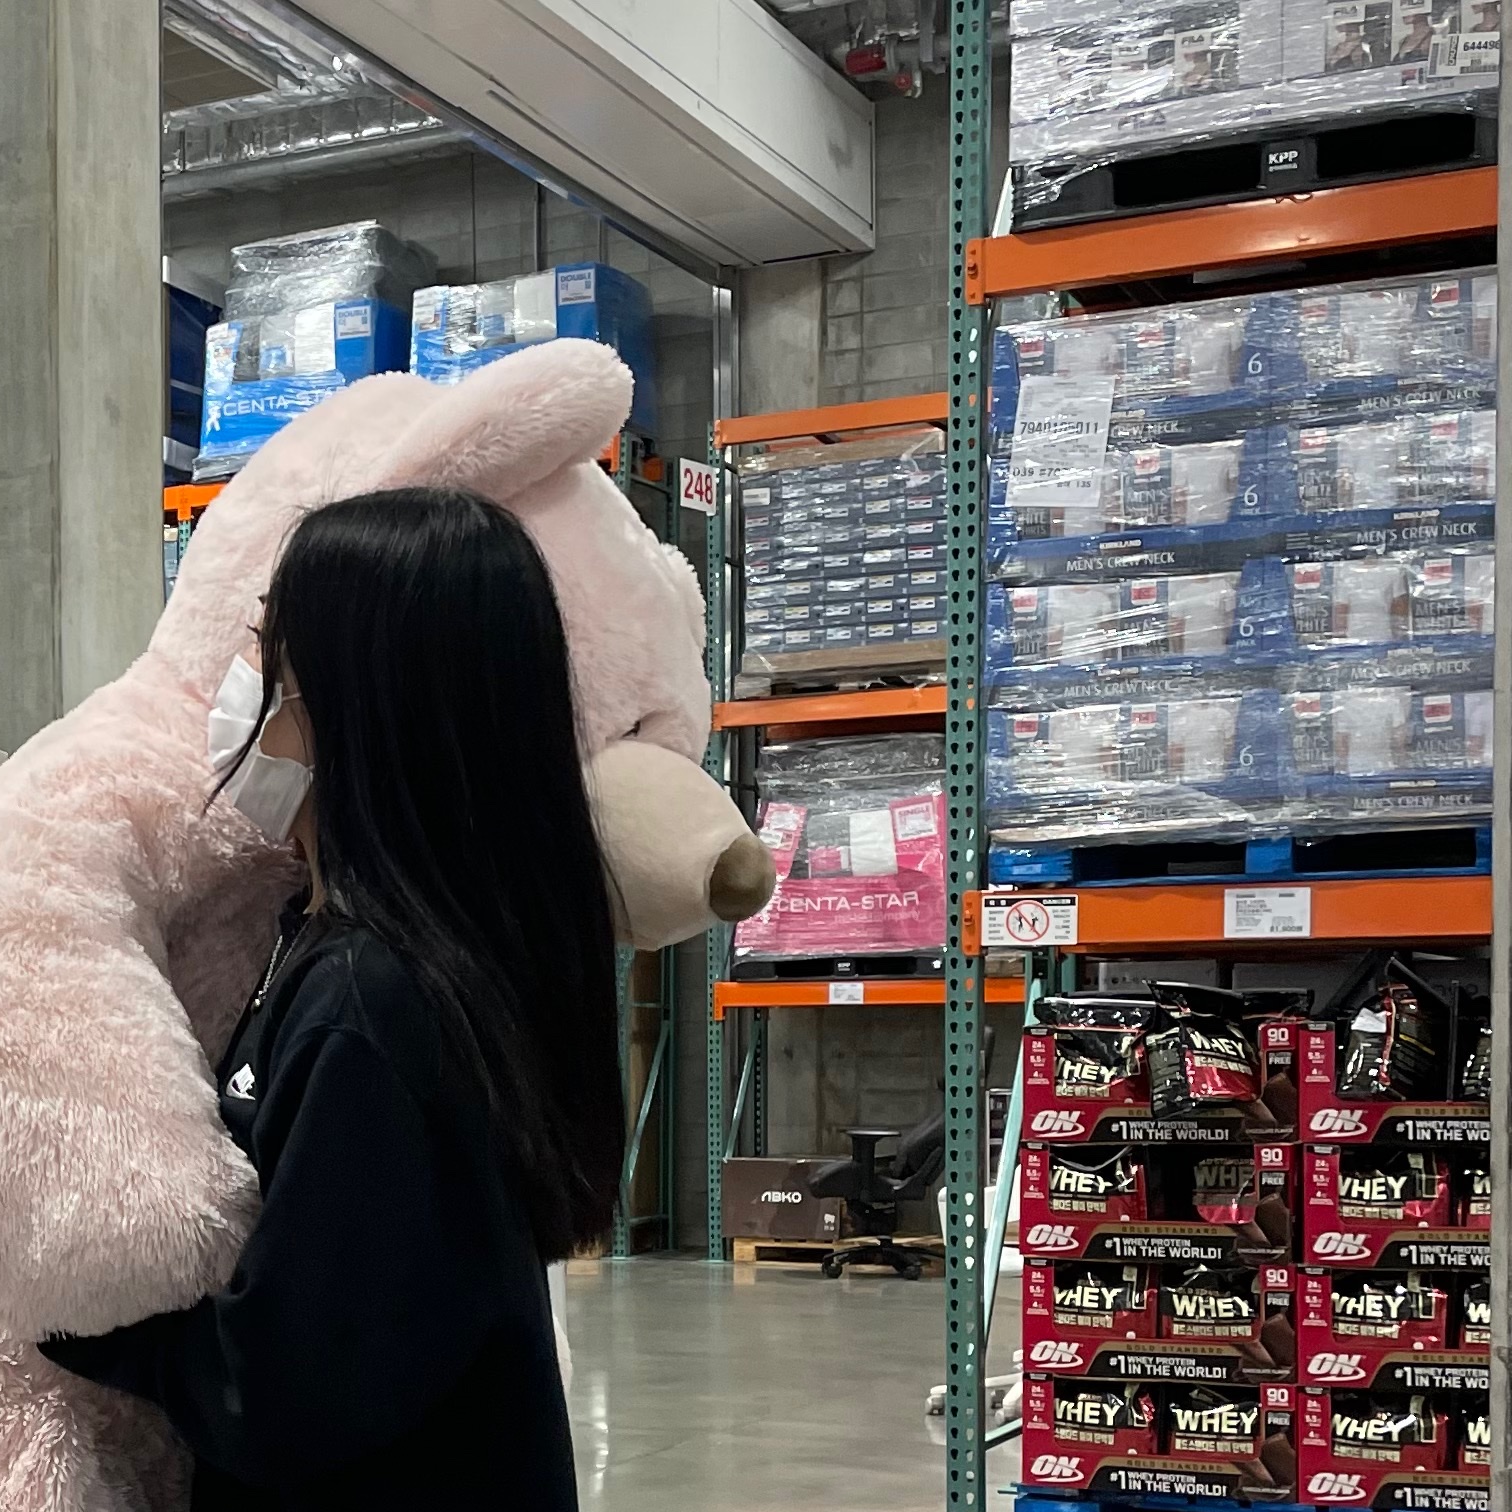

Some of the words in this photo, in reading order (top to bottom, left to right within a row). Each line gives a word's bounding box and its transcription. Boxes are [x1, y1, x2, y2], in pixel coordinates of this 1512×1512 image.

[1268, 150, 1299, 165] KPP
[1247, 352, 1262, 375] 6
[683, 467, 714, 505] 248
[1244, 484, 1258, 507] 6
[1356, 527, 1397, 544] MEN'S
[1401, 524, 1439, 540] CREW
[1442, 522, 1477, 536] NECK
[1066, 556, 1104, 572] MEN'S
[1142, 551, 1176, 565] NECK
[1239, 616, 1255, 638] 6
[1239, 745, 1254, 767] 6
[777, 890, 920, 913] CENTA-STAR
[1189, 1029, 1246, 1060] WHEY
[1267, 1027, 1289, 1042] 90
[1031, 1109, 1083, 1134] ON
[1111, 1121, 1128, 1140] #1
[1310, 1109, 1366, 1134] ON
[1396, 1120, 1414, 1140] #1
[1130, 1129, 1144, 1140] IN
[1146, 1129, 1173, 1140] THE
[1176, 1129, 1229, 1141] WORLD!
[1416, 1129, 1431, 1140] IN
[1435, 1129, 1463, 1140] THE
[1261, 1148, 1283, 1163] 90
[1026, 1224, 1078, 1249] ON
[1104, 1237, 1122, 1256] #1
[1313, 1233, 1369, 1258] ON
[1123, 1246, 1137, 1257] IN
[1140, 1246, 1166, 1258] THE
[1170, 1247, 1222, 1260] WORLD!
[1400, 1245, 1418, 1265] #1
[1420, 1253, 1435, 1265] IN
[1439, 1254, 1467, 1266] THE
[1265, 1269, 1288, 1284] 90
[1172, 1294, 1252, 1318] WHEY
[1029, 1341, 1082, 1366] ON
[1109, 1355, 1127, 1375] #1
[1128, 1364, 1142, 1375] IN
[1145, 1365, 1171, 1376] THE
[1175, 1366, 1227, 1379] WORLD!
[1307, 1353, 1365, 1379] ON
[1394, 1367, 1412, 1387] #1
[1415, 1376, 1430, 1387] IN
[1434, 1376, 1461, 1388] THE
[1266, 1388, 1288, 1403] 90
[1176, 1408, 1258, 1434] WHEY
[1031, 1454, 1083, 1479] ON
[1110, 1470, 1127, 1490] #1
[1128, 1479, 1142, 1491] IN
[1145, 1480, 1171, 1492] THE
[1175, 1482, 1227, 1496] WORLD!
[1307, 1472, 1365, 1499] ON
[1394, 1487, 1412, 1507] #1
[1415, 1497, 1430, 1508] IN
[1434, 1498, 1461, 1510] THE
